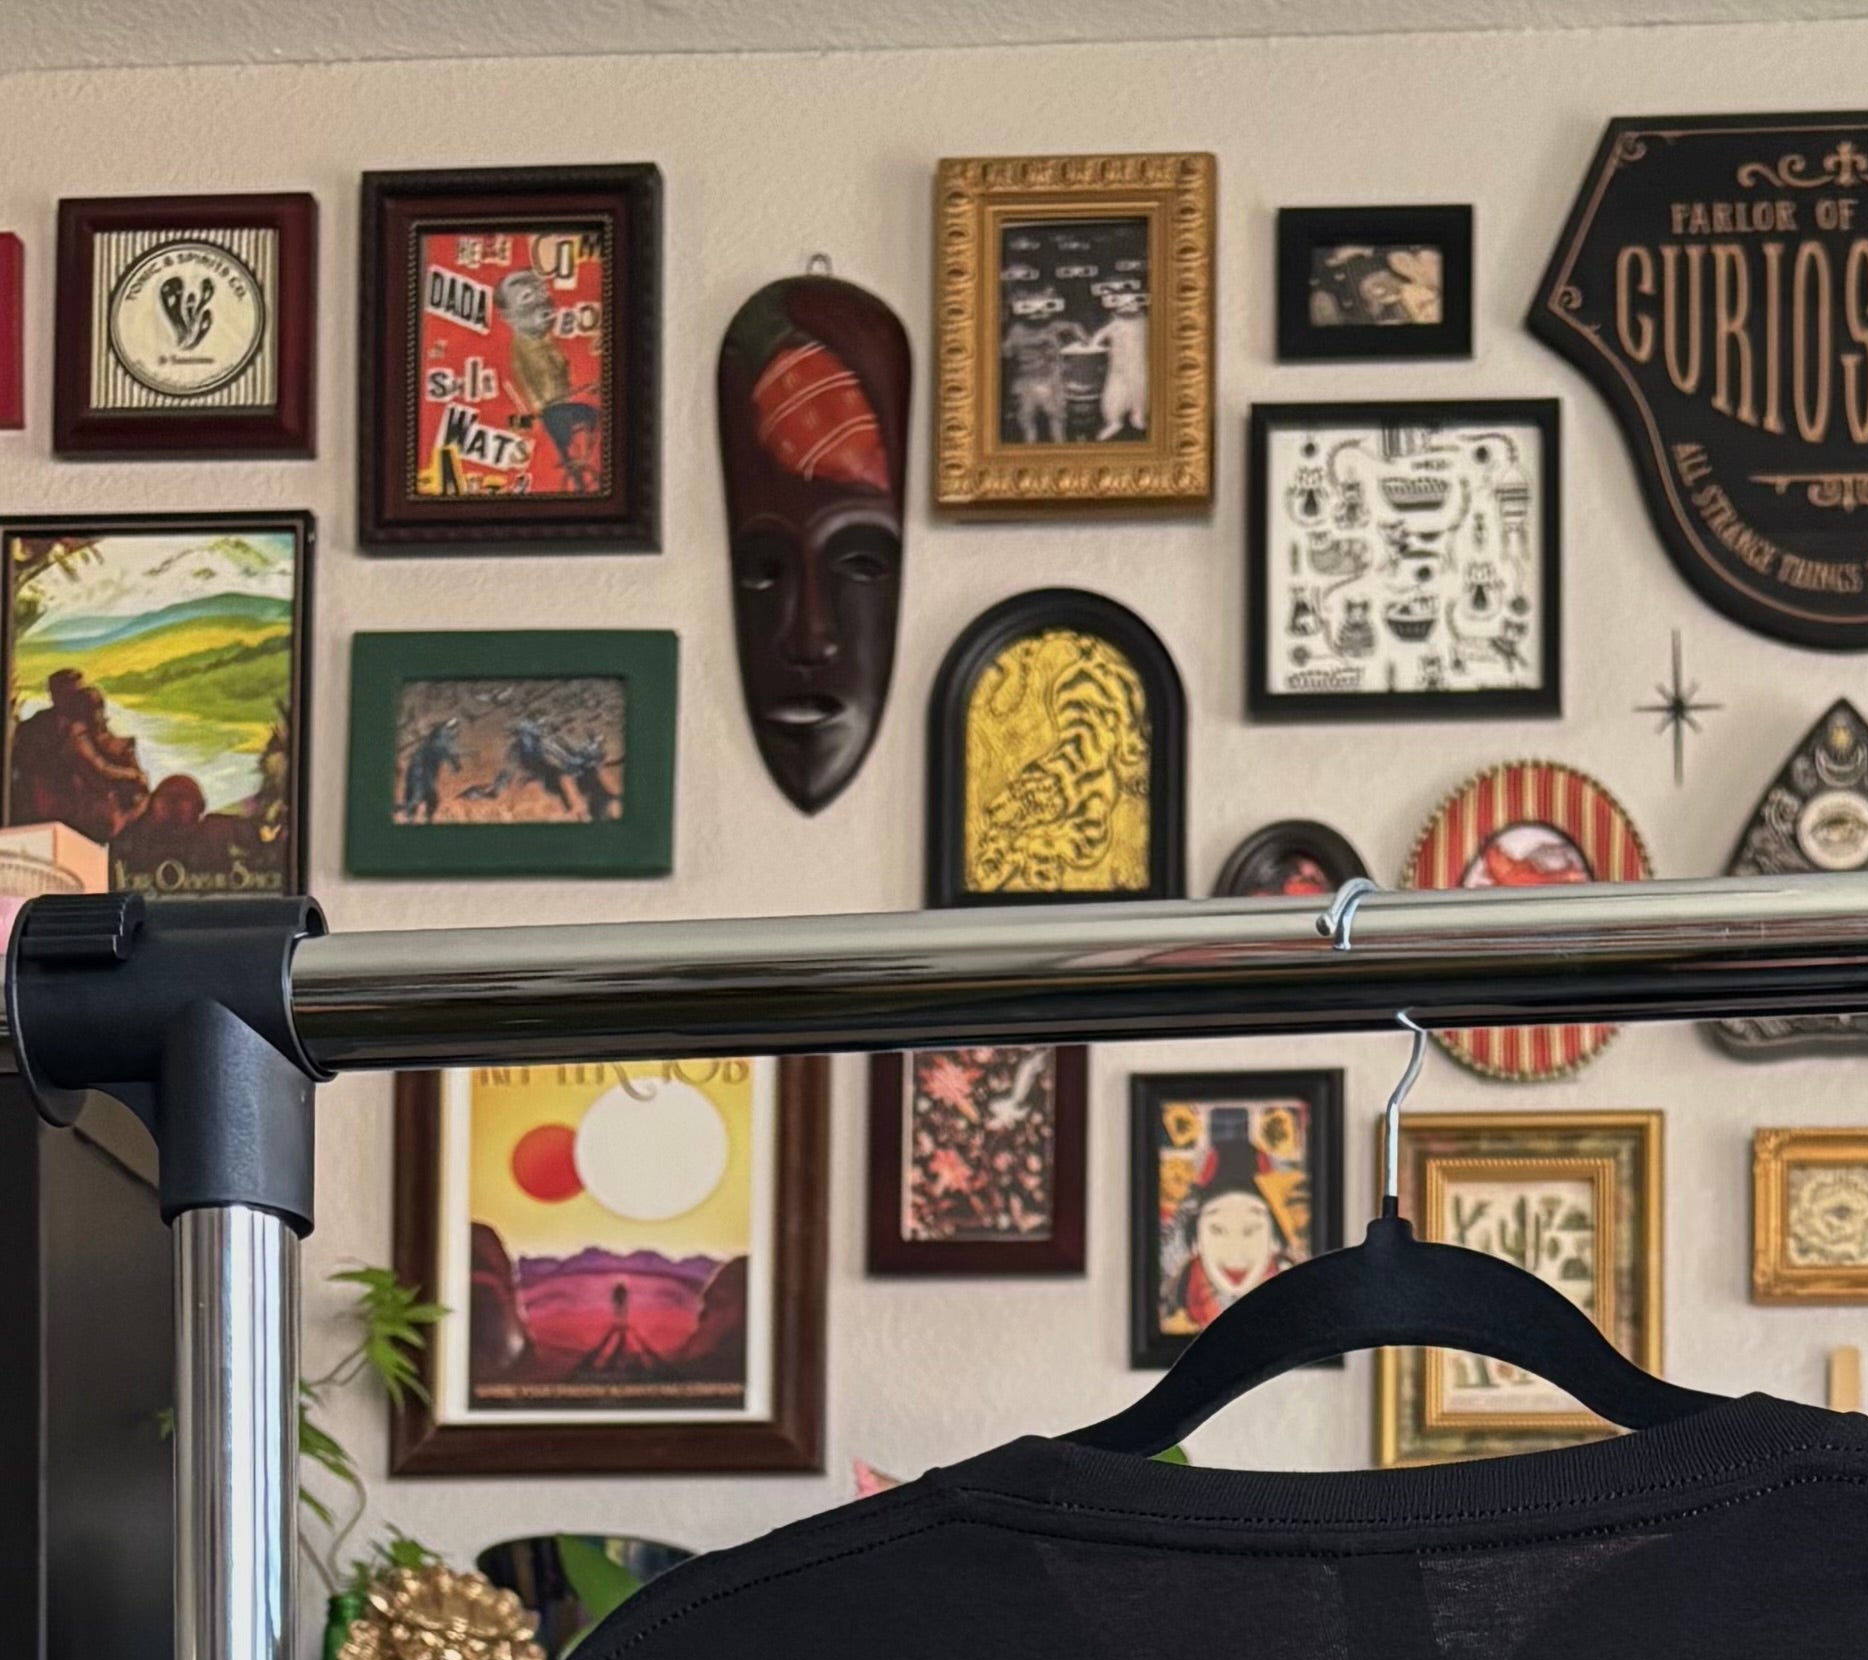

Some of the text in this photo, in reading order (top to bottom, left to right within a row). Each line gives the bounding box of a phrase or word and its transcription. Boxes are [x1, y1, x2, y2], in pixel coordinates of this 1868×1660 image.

[1670, 201, 1800, 236] PARLOR
[1815, 199, 1859, 231] OF
[430, 271, 488, 330] DADA
[1673, 443, 1712, 487] ALL
[1691, 485, 1777, 575] STRANGE
[1777, 554, 1864, 593] THINGS
